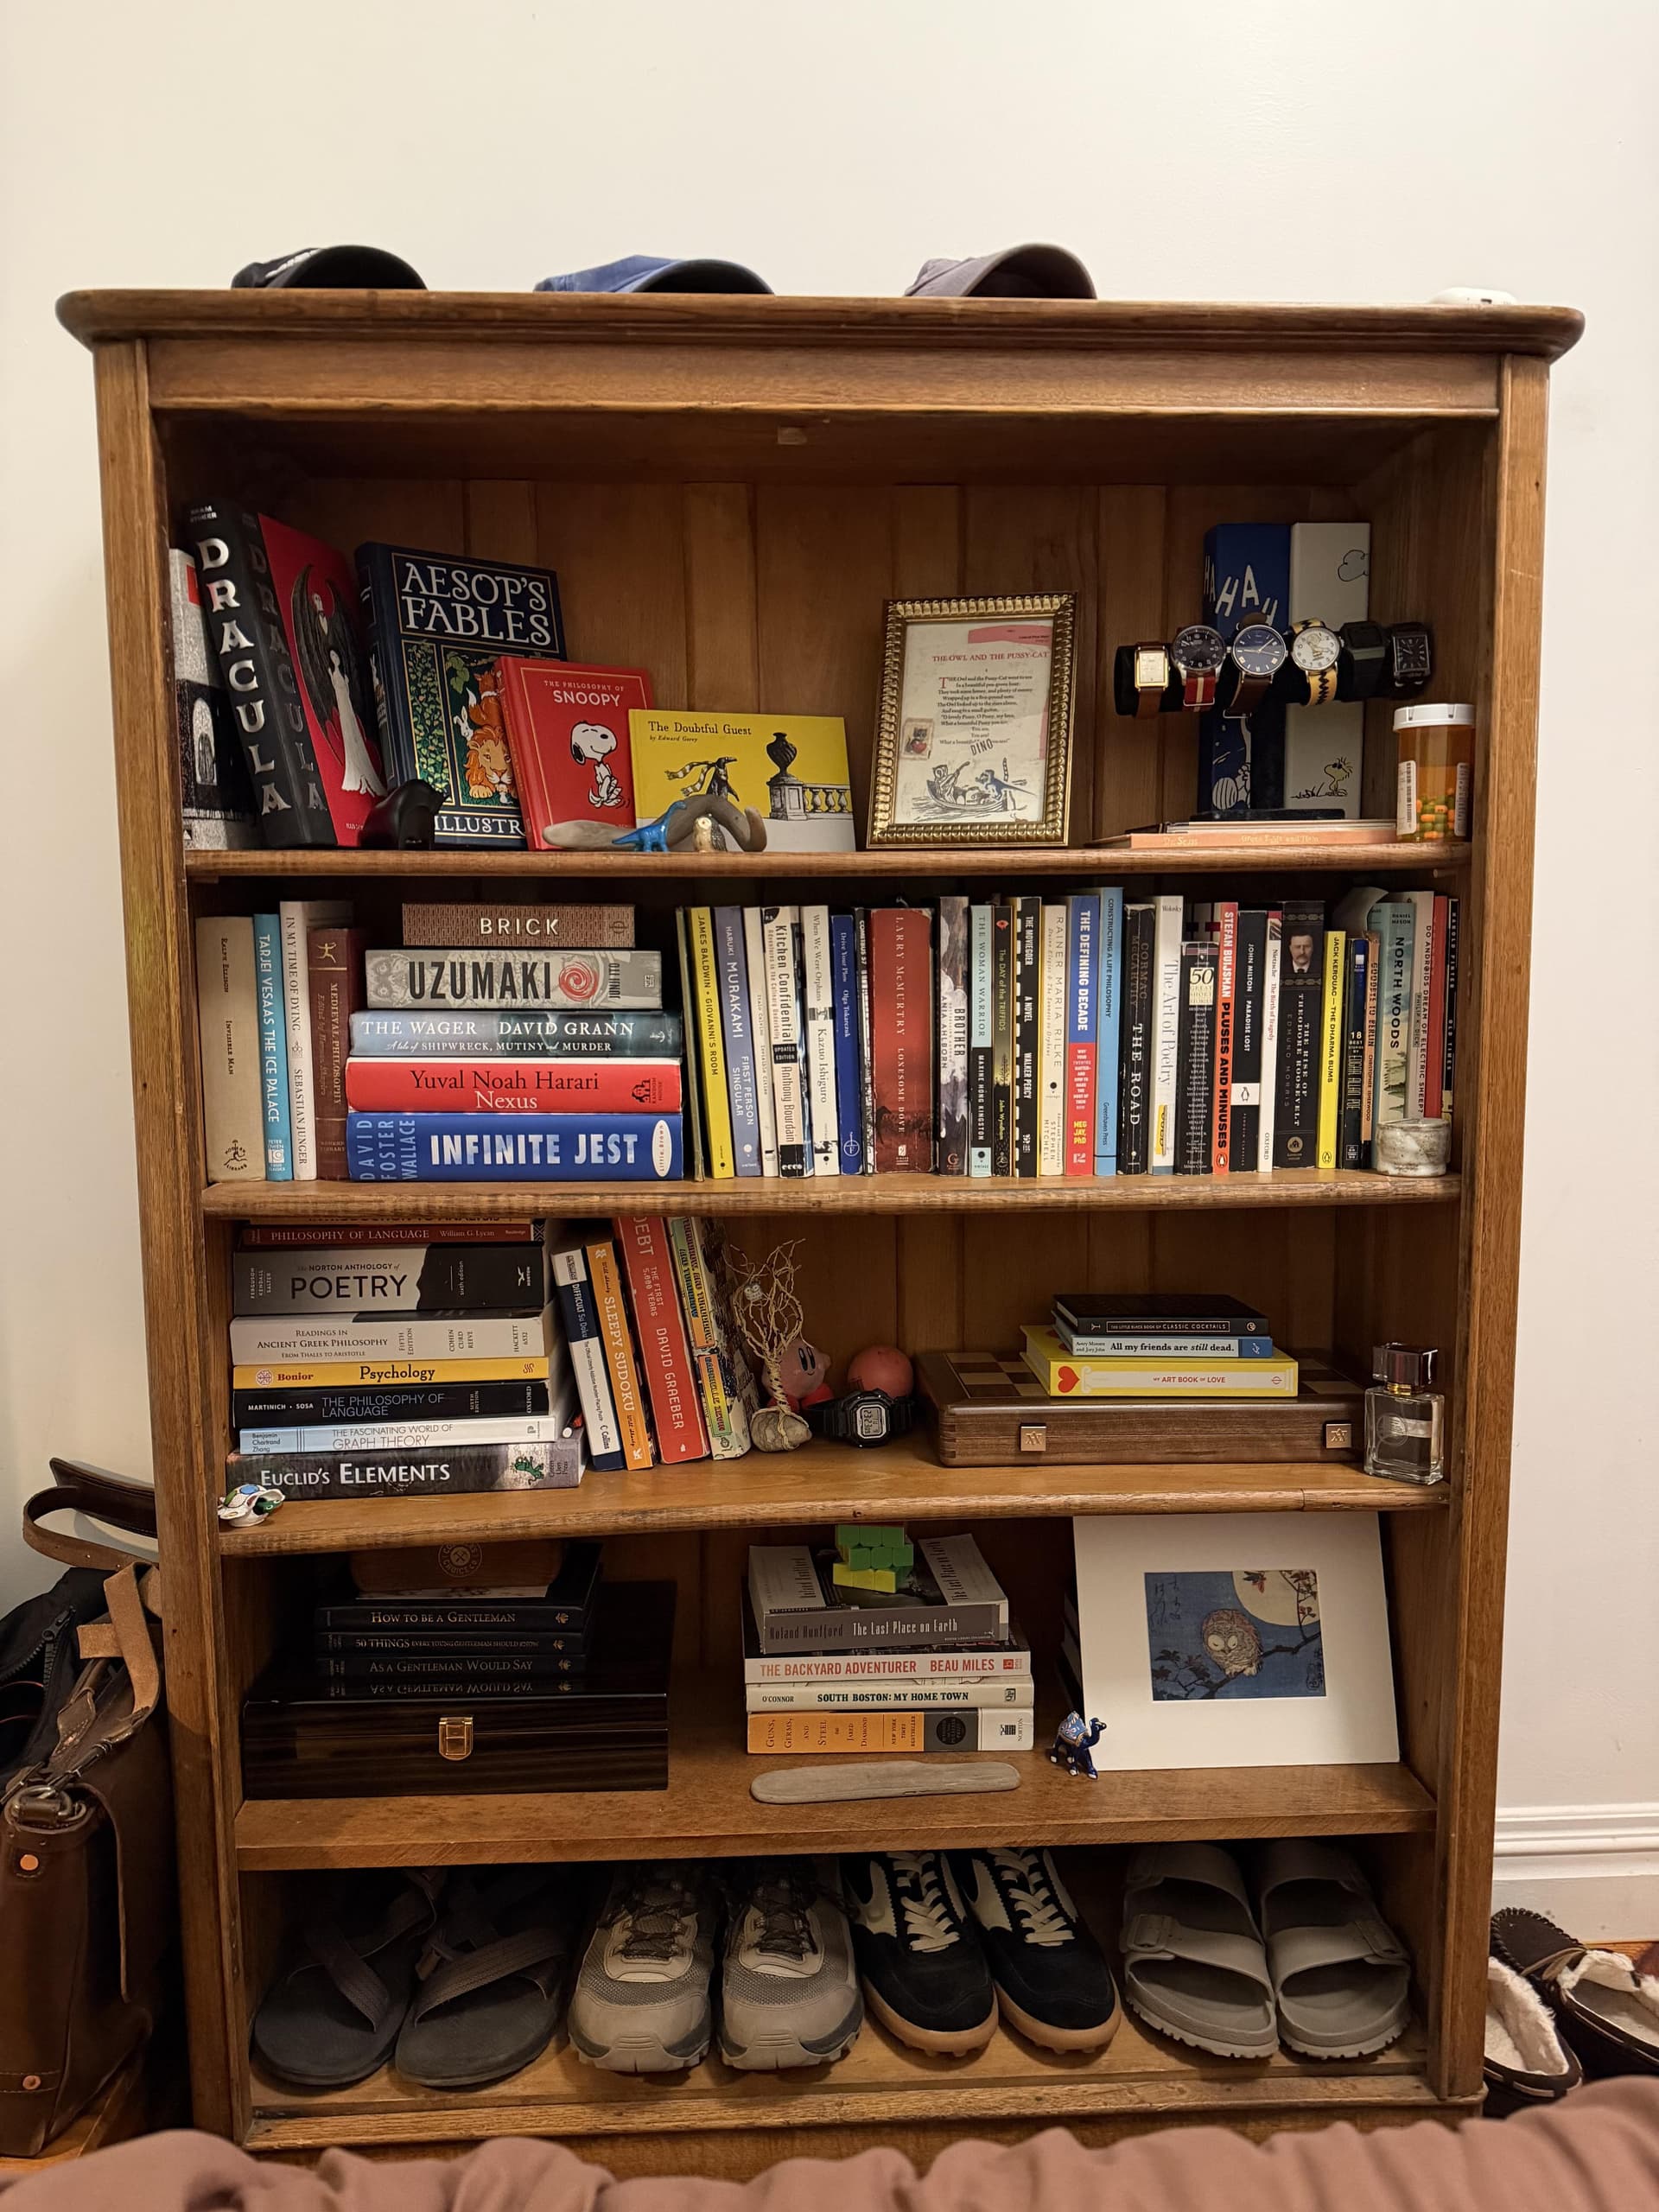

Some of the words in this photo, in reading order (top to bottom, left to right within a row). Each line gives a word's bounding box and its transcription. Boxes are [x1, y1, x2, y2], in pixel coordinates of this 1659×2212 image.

[401, 562, 547, 612] AESOP'S
[1215, 565, 1260, 617] HA
[401, 596, 551, 647] FABLES
[1007, 651, 1050, 659] PUSSY-CAT
[196, 537, 291, 816] DRACULA
[553, 690, 620, 707] SNOOPY
[648, 721, 669, 732] The
[674, 721, 719, 734] Doubtful
[722, 724, 752, 735] Guest
[970, 739, 994, 755] DINO
[480, 918, 560, 935] BRICK
[698, 916, 707, 945] JAMES
[1080, 910, 1091, 931] THE
[1224, 912, 1234, 947] STEFAN
[1426, 925, 1432, 938] DO
[259, 934, 272, 972] TARJEI
[725, 926, 734, 956] HARUKI
[776, 925, 788, 968] Kitchen
[814, 938, 821, 950] We
[701, 948, 711, 988] BALDWIN
[1078, 934, 1090, 986] DEFINING
[1222, 950, 1233, 998] BUIJSMAN
[1393, 937, 1405, 988] NORTH
[408, 961, 551, 1000] UZUMAKI
[1190, 969, 1214, 985] 50
[262, 976, 274, 1025] VESAAS
[727, 962, 743, 1038] MURAKAMI
[779, 973, 793, 1042] Confidential
[1024, 1002, 1033, 1023] NOVEL
[1077, 988, 1089, 1031] DECADE
[361, 1021, 402, 1035] THE
[410, 1021, 477, 1035] WAGER
[499, 1022, 557, 1035] DAVID
[564, 1022, 634, 1035] GRANN
[705, 998, 716, 1049] GIOVANNI'S
[954, 1008, 965, 1056] BROTHER
[1220, 1002, 1230, 1054] PLUSES
[1390, 994, 1402, 1049] WOODS
[1421, 1023, 1427, 1033] OF
[264, 1030, 276, 1052] THE
[422, 1042, 493, 1052] SHIPWRECK,
[496, 1042, 543, 1051] MUTINY
[563, 1042, 612, 1052] MURDER
[1132, 1023, 1142, 1061] THE
[265, 1057, 276, 1074] ICE
[410, 1070, 464, 1089] Yuval
[473, 1070, 526, 1090] Noah
[536, 1071, 599, 1090] Harari
[741, 1056, 751, 1080] FIRST
[1219, 1058, 1229, 1086] AND
[266, 1078, 280, 1122] PALACE
[295, 1069, 305, 1123] SEBASTIAN
[474, 1090, 537, 1109] Nexus
[733, 1067, 744, 1116] SINGULAR
[781, 1066, 792, 1103] Anthony
[1130, 1071, 1141, 1125] ROAD
[744, 1086, 754, 1125] PERSON
[1218, 1089, 1229, 1148] MINUSES
[785, 1105, 796, 1142] Bourdain
[296, 1126, 308, 1164] JUNGER
[357, 1120, 374, 1181] DAVID
[378, 1120, 395, 1181] FOSTER
[399, 1120, 416, 1181] WALLACE
[430, 1134, 561, 1165] INFINITE
[575, 1134, 638, 1165] JEST
[291, 1274, 407, 1300] POETRY
[643, 1268, 652, 1290] 5,000
[647, 1294, 658, 1317] YEARS
[605, 1296, 622, 1347] SLEEPY
[614, 1351, 634, 1411] SUDOKU
[657, 1328, 672, 1367] DAVID
[1191, 1343, 1208, 1351] still
[1210, 1343, 1235, 1351] dead.
[277, 1372, 314, 1381] Bonior
[359, 1363, 435, 1382] Psychology
[321, 1396, 348, 1407] THE
[349, 1394, 425, 1406] PHILOSOPHY
[429, 1393, 445, 1403] OF
[322, 1405, 388, 1418] LANGUAGE
[664, 1372, 684, 1429] GRAEBER
[333, 1438, 376, 1450] GRAPH
[380, 1435, 429, 1447] THEORY
[261, 1467, 330, 1486] EUCLID'S
[340, 1463, 450, 1484] ELEMENTS
[372, 1611, 402, 1623] HOW
[404, 1613, 418, 1623] TO
[422, 1613, 433, 1623] BE
[436, 1613, 443, 1623] A
[448, 1611, 516, 1623] GENTLEMAN
[370, 1662, 385, 1672] AS
[386, 1662, 393, 1672] A
[397, 1661, 462, 1672] GENTLEMAN
[467, 1659, 511, 1671] WOULD
[513, 1659, 533, 1671] SAY
[760, 1664, 780, 1676] THE
[785, 1662, 842, 1676] BACKYARD
[845, 1661, 917, 1675] ADVENTURER
[930, 1660, 958, 1672] BEAU
[963, 1659, 995, 1671] MILES
[817, 1694, 849, 1702] SOUTH
[853, 1693, 891, 1702] BOSTON:
[893, 1693, 908, 1701] MY
[911, 1693, 938, 1701] HOME
[940, 1692, 969, 1700] TOWN
[766, 1719, 775, 1747] GUNS,
[785, 1719, 793, 1748] GERMS,
